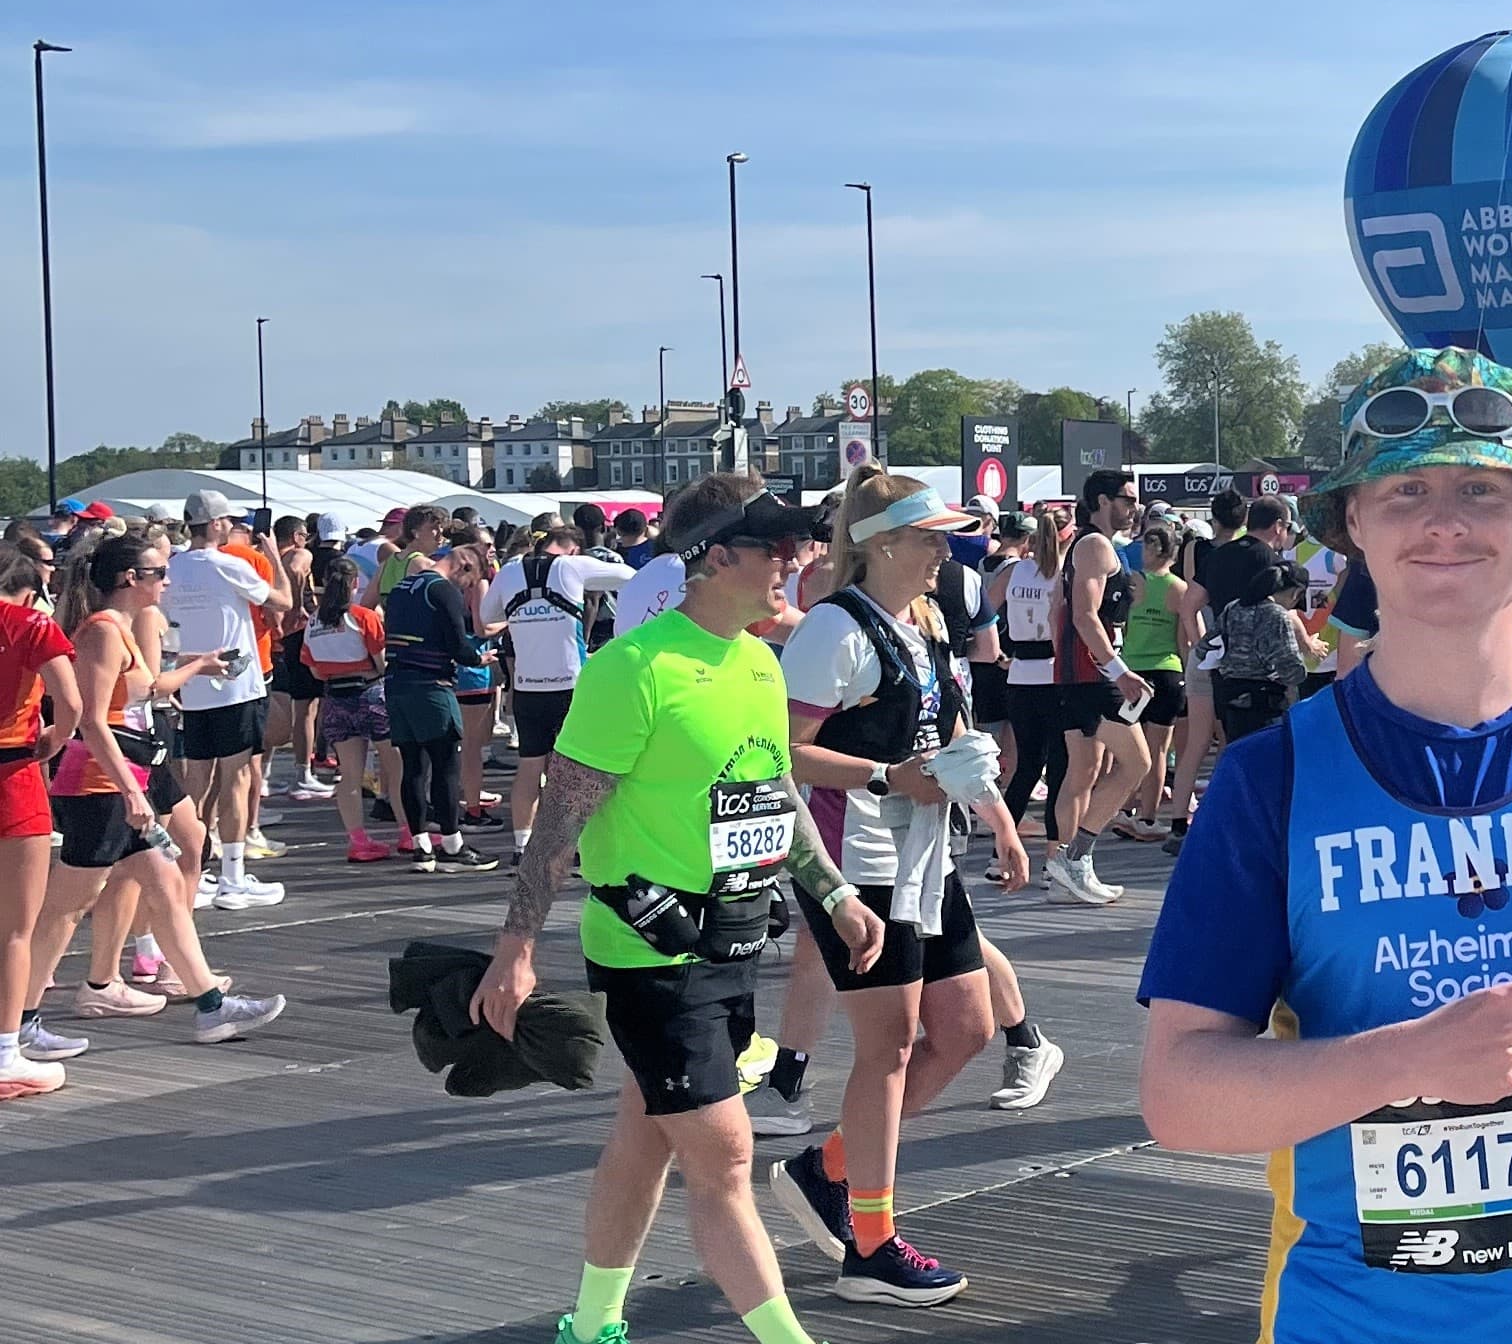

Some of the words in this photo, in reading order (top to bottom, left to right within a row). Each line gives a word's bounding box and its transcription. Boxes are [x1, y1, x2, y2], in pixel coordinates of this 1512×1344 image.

[850, 396, 868, 411] 30
[981, 443, 1003, 453] POINT
[1144, 476, 1168, 492] tcs
[1184, 476, 1208, 493] tcs
[1263, 479, 1278, 492] 30
[717, 789, 752, 817] tcs
[727, 824, 786, 859] 58282
[728, 931, 768, 957] nerd
[1462, 1245, 1504, 1265] new
